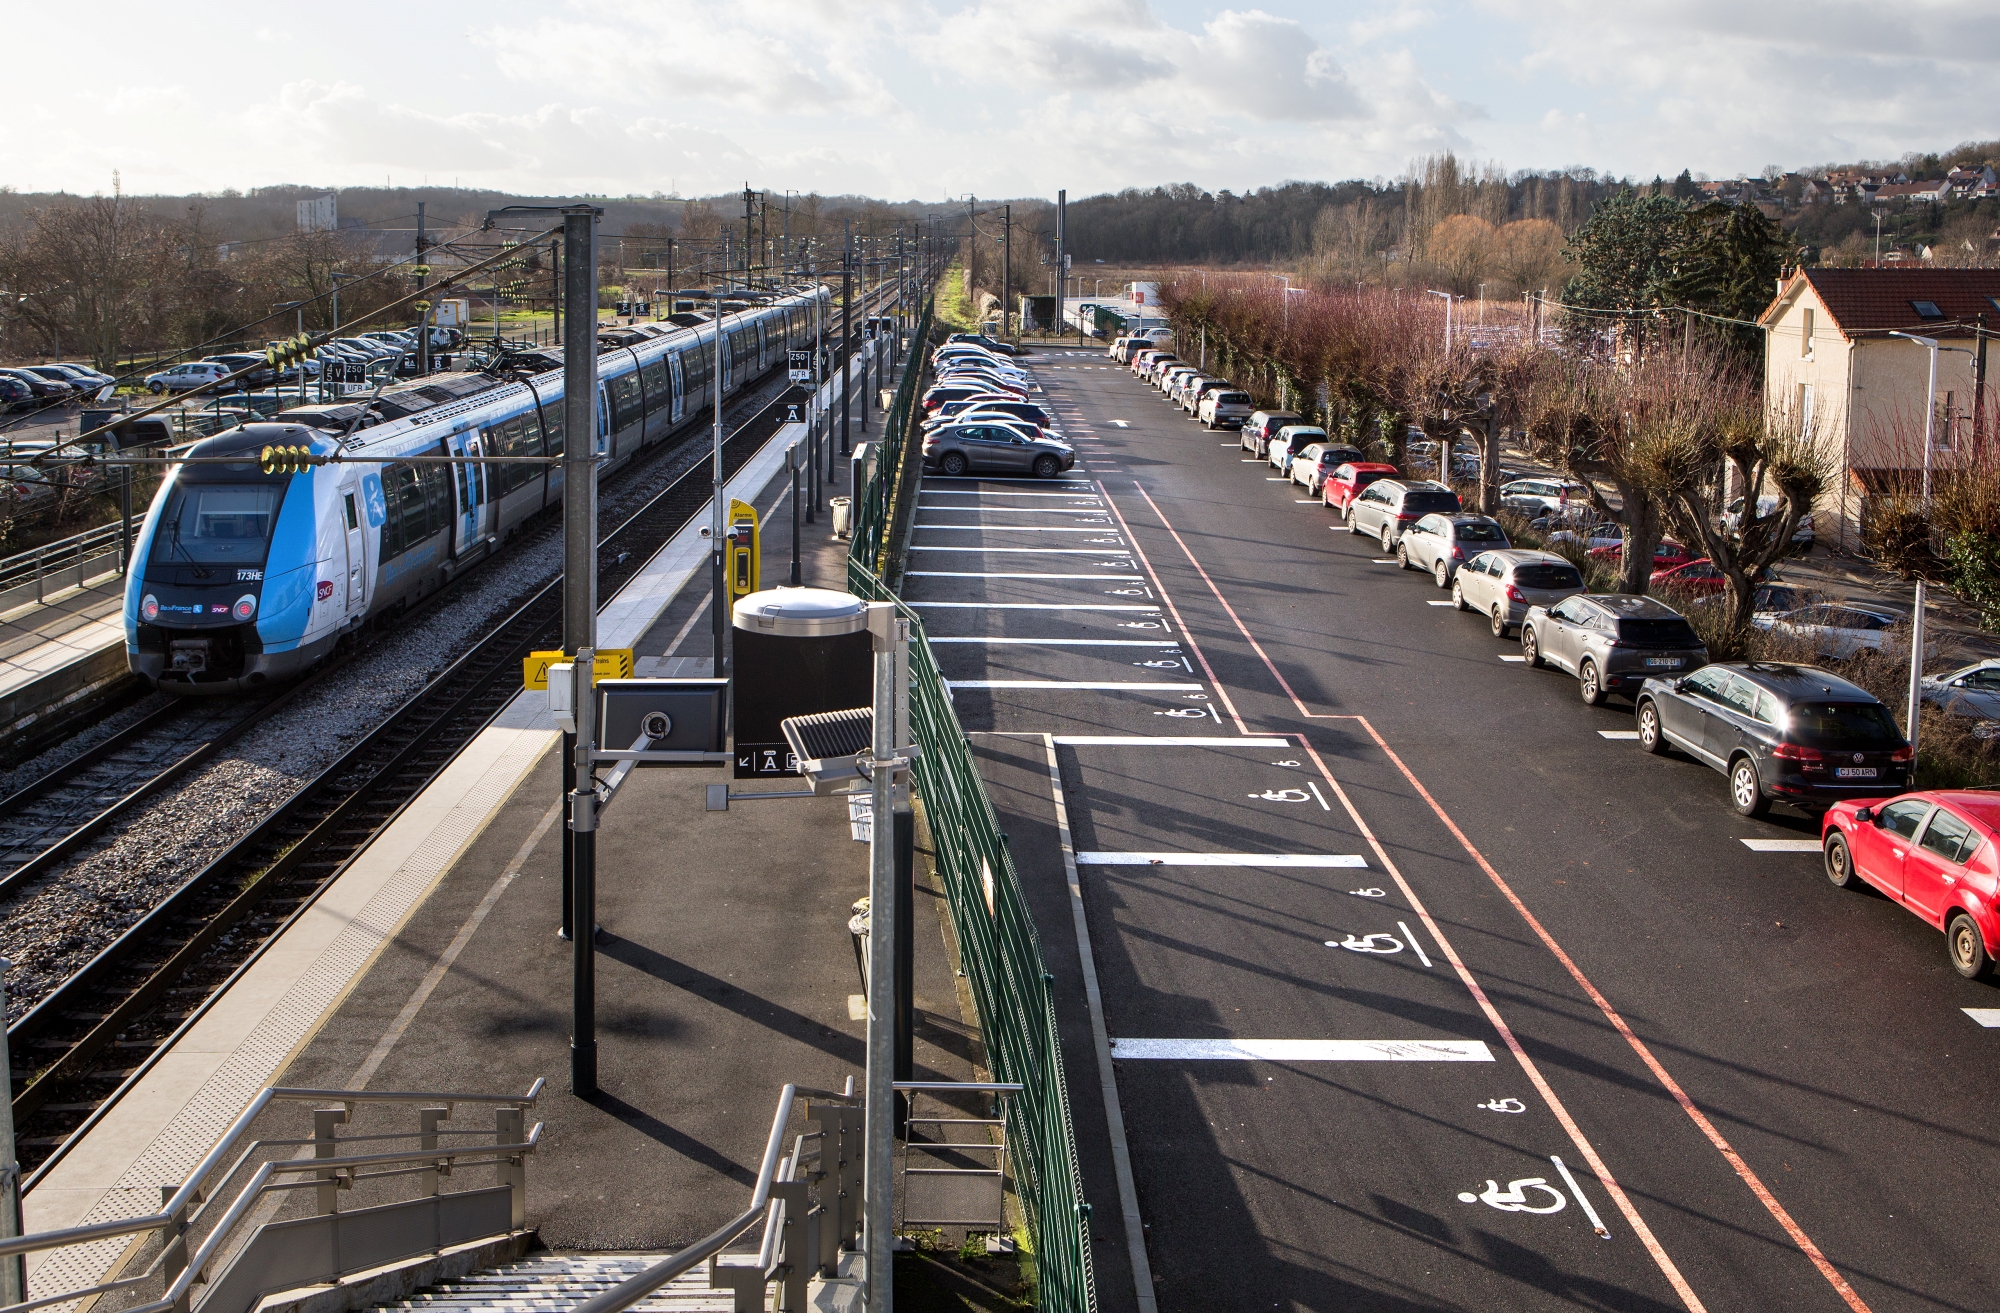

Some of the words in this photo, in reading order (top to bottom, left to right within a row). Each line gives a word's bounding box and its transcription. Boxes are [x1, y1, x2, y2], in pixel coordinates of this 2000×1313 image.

[326, 364, 333, 372] 4
[335, 368, 341, 378] V
[326, 373, 333, 381] 5
[788, 410, 797, 420] A
[237, 571, 263, 581] 173HE
[318, 584, 333, 599] SNCF
[764, 757, 776, 768] A
